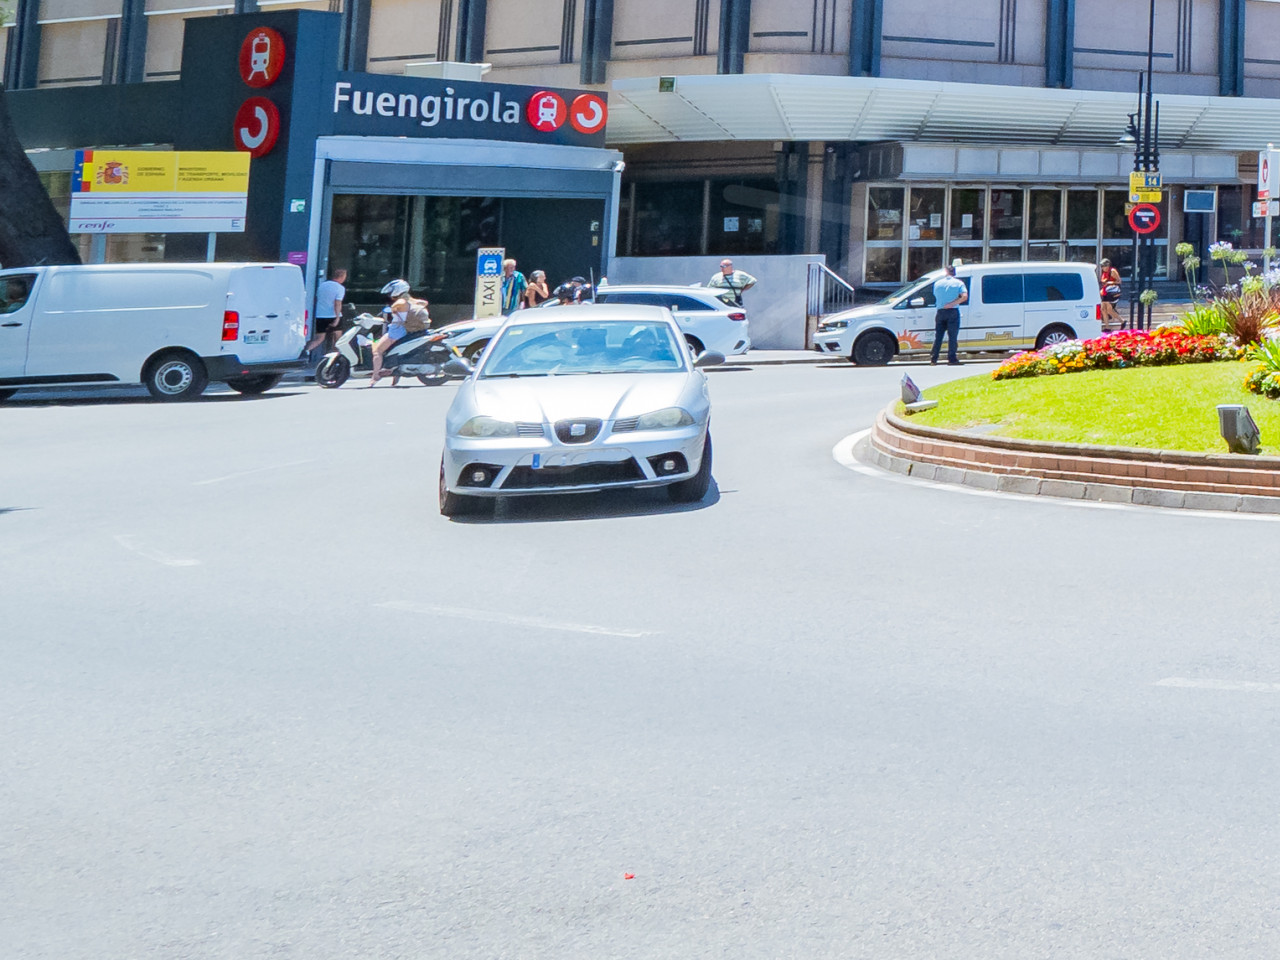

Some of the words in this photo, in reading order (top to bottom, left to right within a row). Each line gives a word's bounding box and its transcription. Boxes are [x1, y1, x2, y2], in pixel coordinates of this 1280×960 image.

[333, 81, 520, 127] Fuengirola
[1147, 177, 1158, 185] 14
[78, 220, 116, 231] renfe
[482, 280, 496, 307] TAXI
